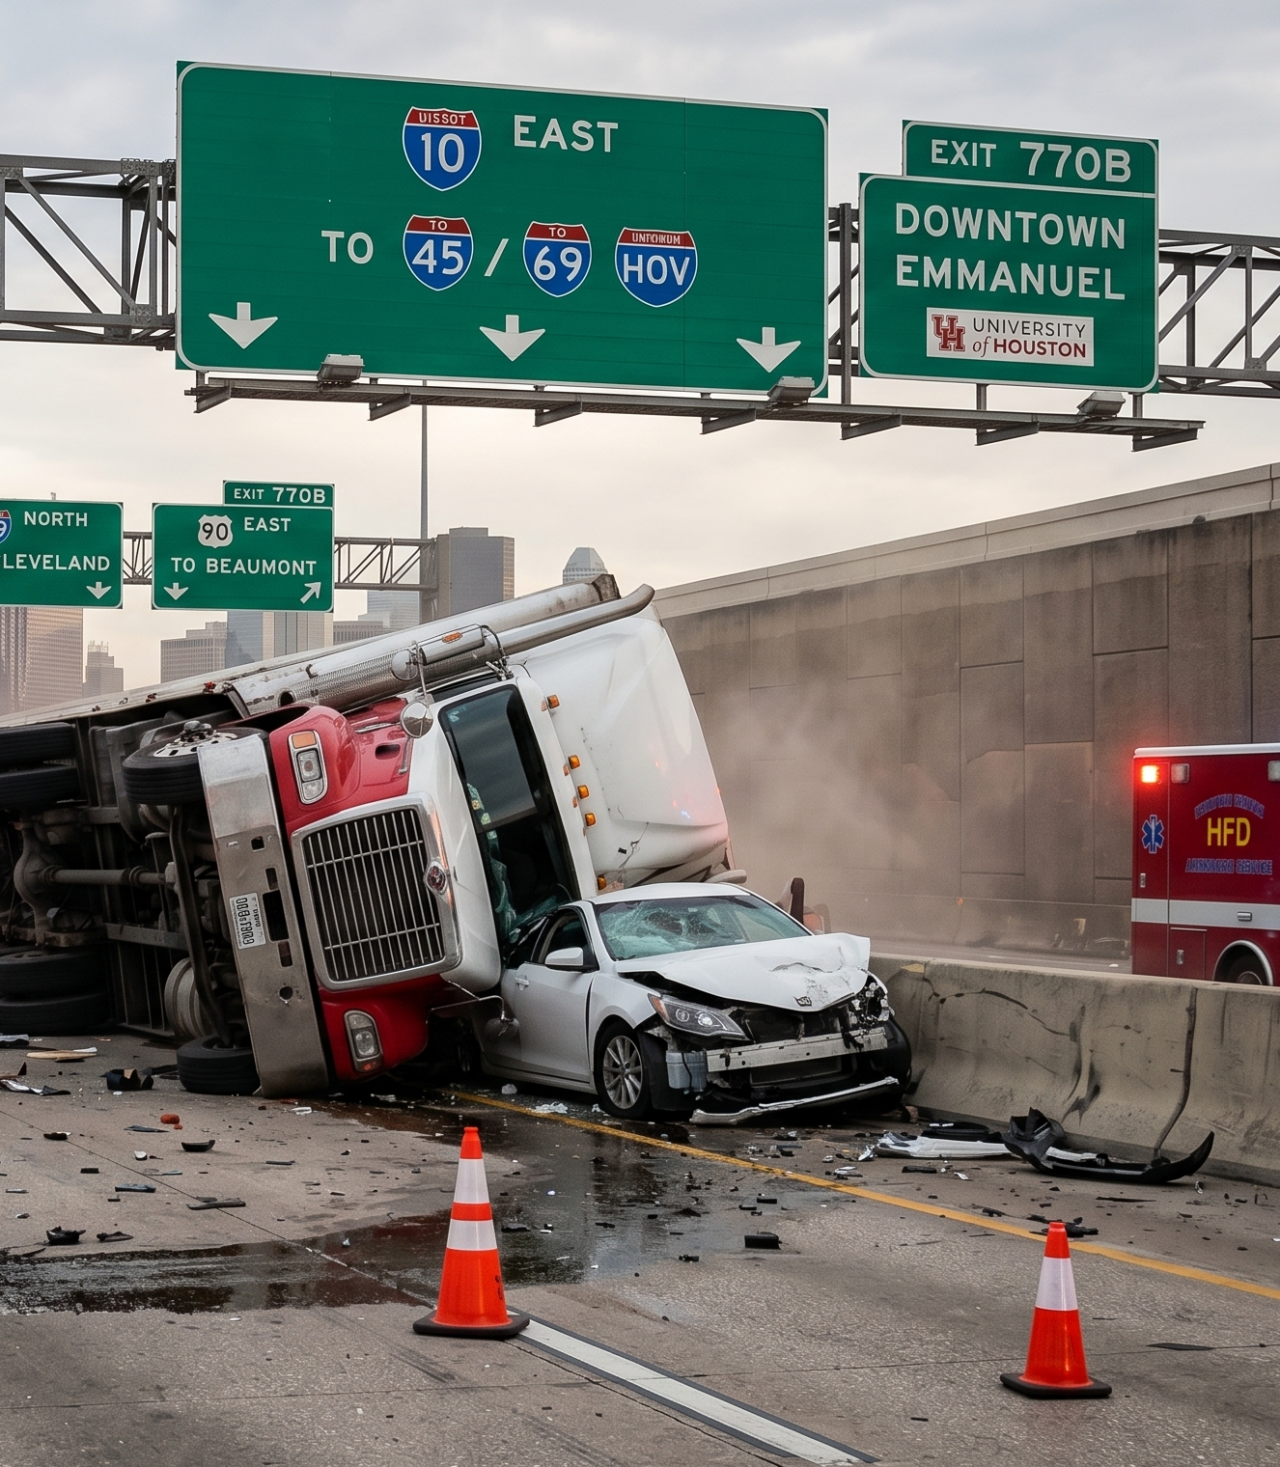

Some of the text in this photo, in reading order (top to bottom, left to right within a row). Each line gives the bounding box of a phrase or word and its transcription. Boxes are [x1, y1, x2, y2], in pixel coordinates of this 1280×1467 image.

[421, 115, 619, 173] 10 EAST
[931, 139, 1132, 184] EXIT 770B
[429, 220, 448, 231] TO
[549, 227, 567, 238] TO
[896, 203, 1126, 250] DOWNTOWN
[321, 229, 690, 286] TO 45 / 69 HOV
[896, 254, 1126, 301] EMMANUEL
[973, 317, 1086, 339] UNIVERSITY
[972, 336, 1086, 358] of HOUSTON
[233, 486, 326, 504] EXIT 770B
[24, 510, 88, 528] NORTH
[202, 517, 292, 541] 90 EAST
[170, 557, 318, 576] TO BEAUMONT
[1207, 817, 1251, 847] HFD
